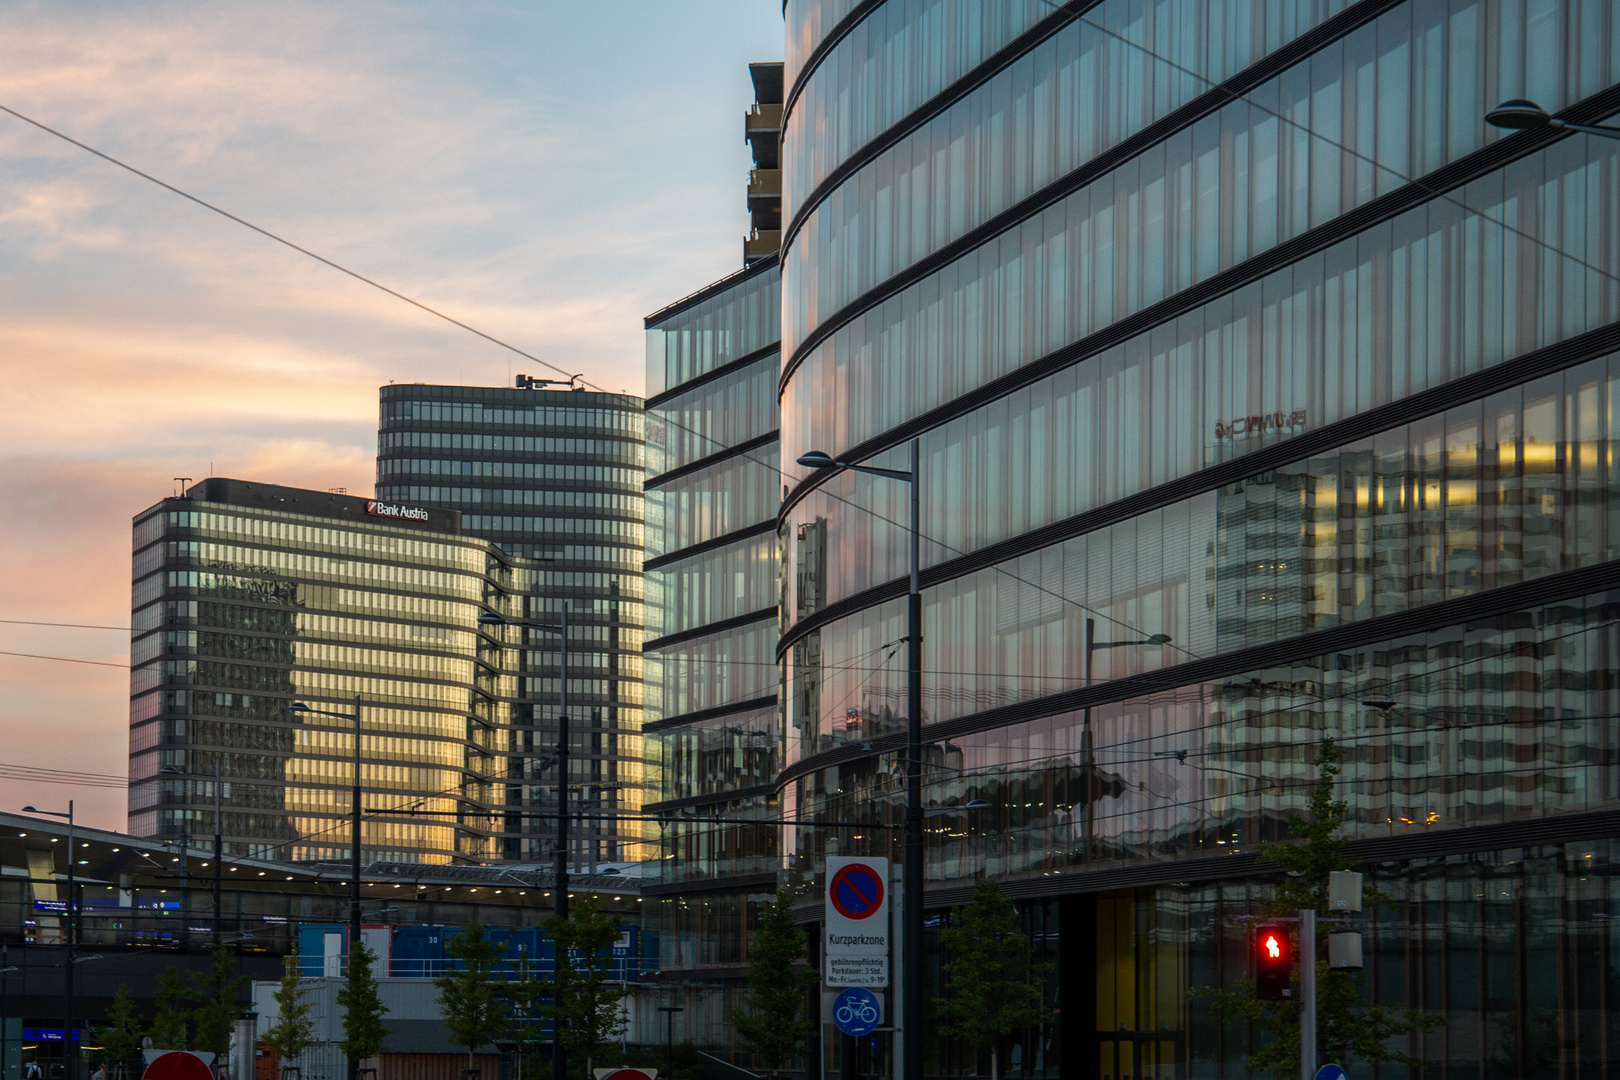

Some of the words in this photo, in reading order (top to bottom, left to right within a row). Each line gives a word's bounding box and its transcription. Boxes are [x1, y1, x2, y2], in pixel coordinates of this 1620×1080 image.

[377, 502, 399, 516] Bank
[400, 505, 428, 520] Austria
[829, 934, 884, 947] Kurzparkzone
[612, 948, 627, 956] 123
[831, 958, 883, 967] gebührenpflichtig
[865, 967, 869, 975] 3
[870, 967, 882, 975] Std.
